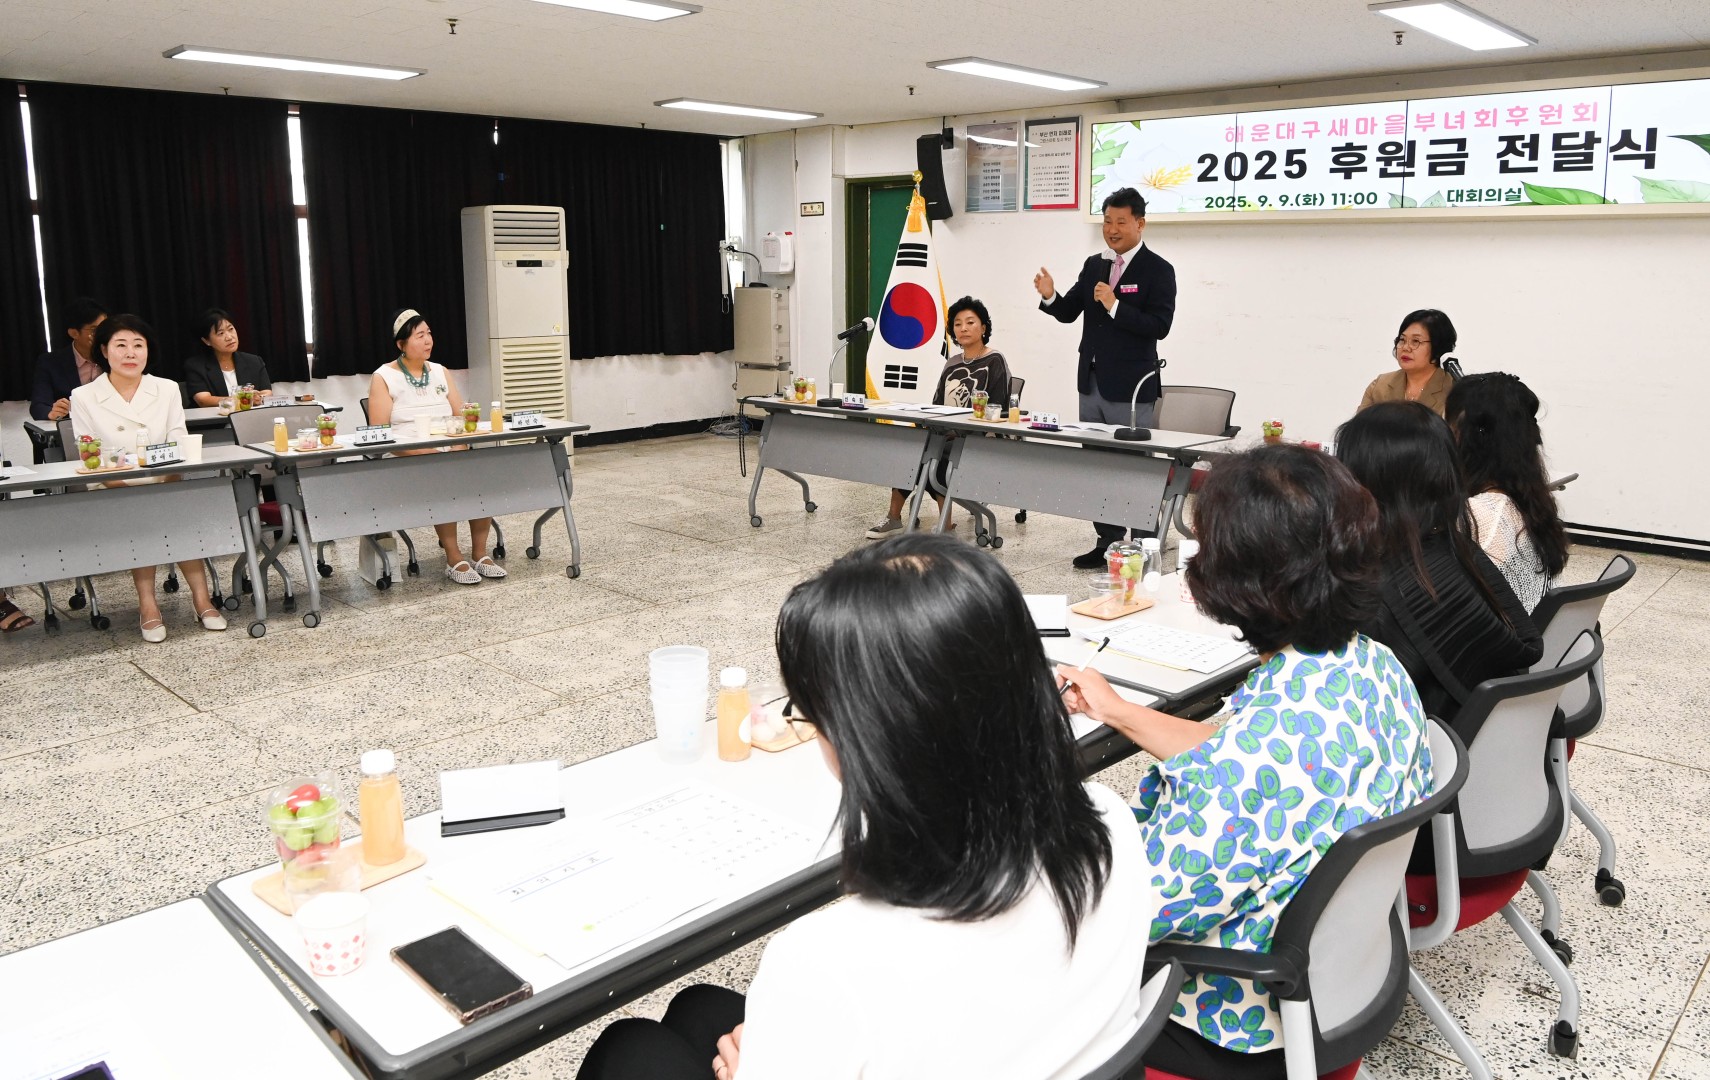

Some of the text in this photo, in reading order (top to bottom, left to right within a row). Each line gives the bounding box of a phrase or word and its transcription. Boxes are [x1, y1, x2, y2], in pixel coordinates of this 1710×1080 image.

[1196, 126, 1659, 183] 2025 후원금 전달식
[1204, 191, 1378, 209] 2025. 9. 9.(화) 11:00
[1446, 187, 1522, 203] 대회의실
